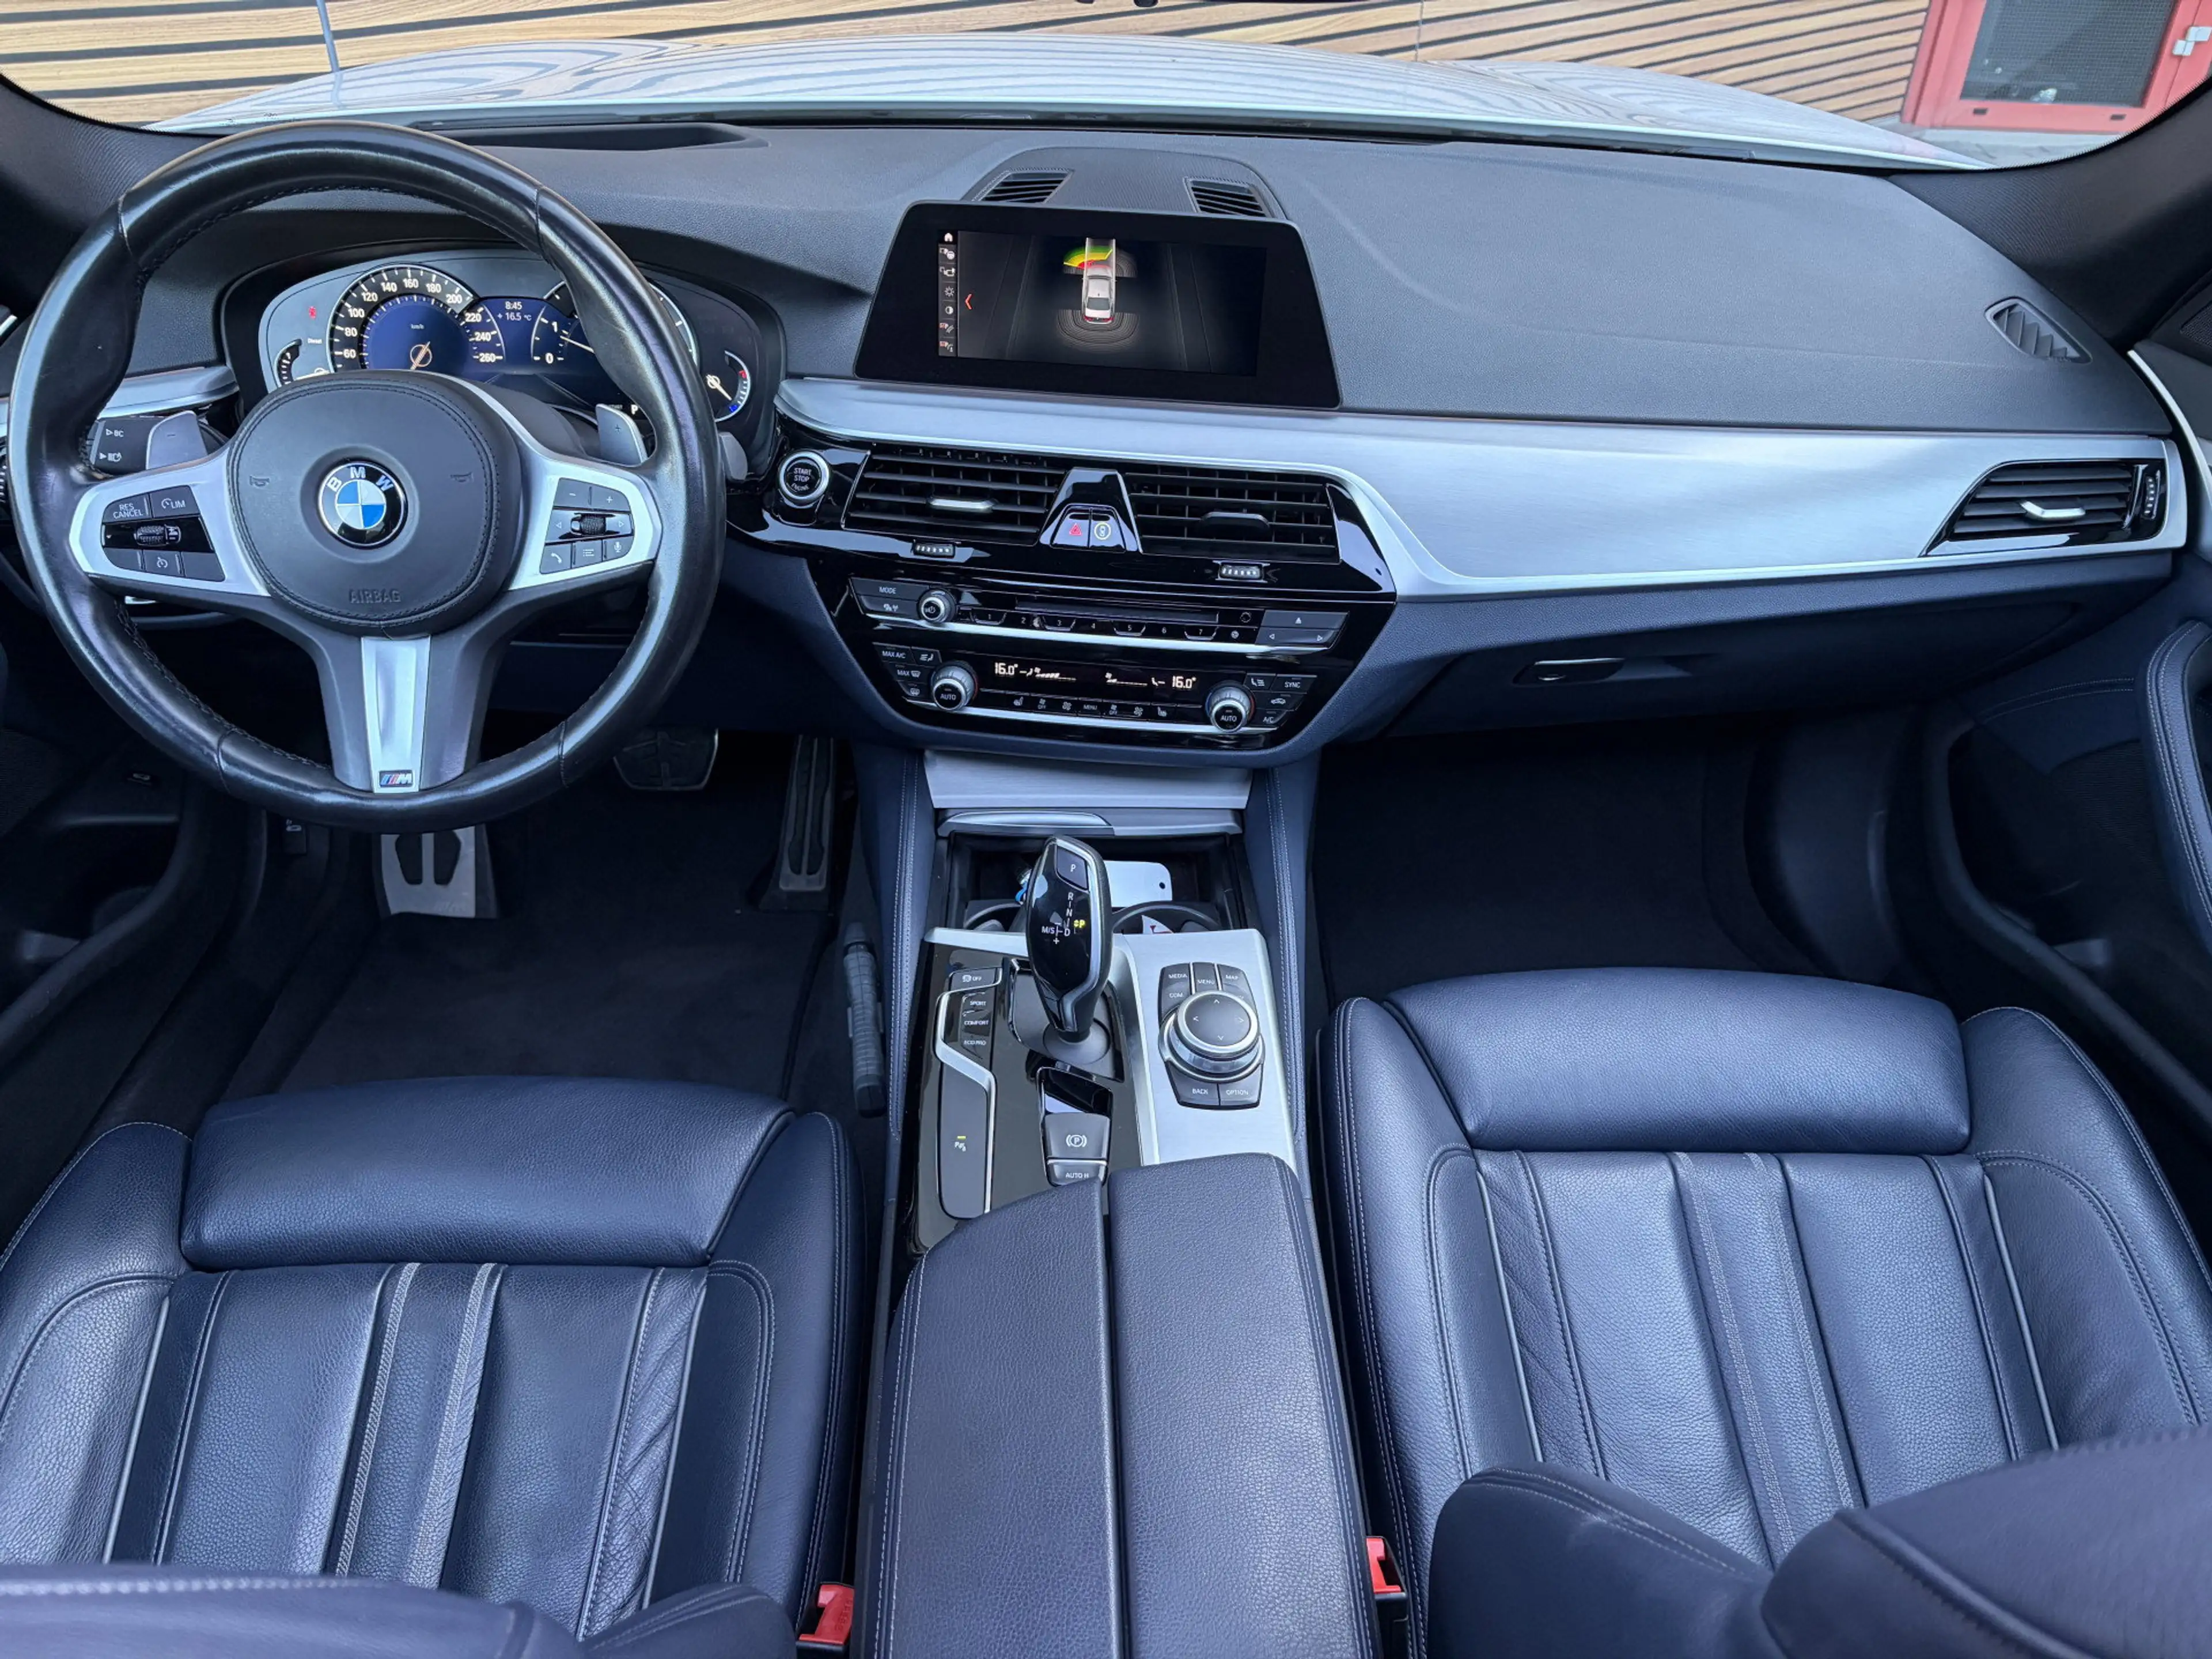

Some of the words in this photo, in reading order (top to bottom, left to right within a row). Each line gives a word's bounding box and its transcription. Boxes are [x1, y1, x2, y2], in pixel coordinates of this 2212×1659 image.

[382, 283, 397, 292] 140
[404, 279, 419, 288] 160
[427, 283, 441, 293] 180
[362, 292, 378, 302] 120
[446, 294, 463, 304] 200
[505, 301, 522, 309] 8:45
[349, 309, 365, 318] 100
[465, 313, 482, 323] 220
[551, 321, 558, 333] 1
[344, 328, 357, 337] 80
[475, 332, 491, 342] 240
[344, 349, 356, 358] 60
[479, 353, 496, 362] 260
[545, 354, 554, 364] 0
[327, 466, 394, 493] BMW
[113, 509, 143, 519] CANCEL
[879, 586, 897, 594] MODE
[349, 590, 402, 604] AIRBAG
[1284, 681, 1301, 689] SYNC
[1070, 864, 1076, 872] P
[1068, 892, 1074, 900] R
[1066, 908, 1073, 916] N
[1041, 926, 1055, 934] M/S
[1064, 928, 1070, 937] D
